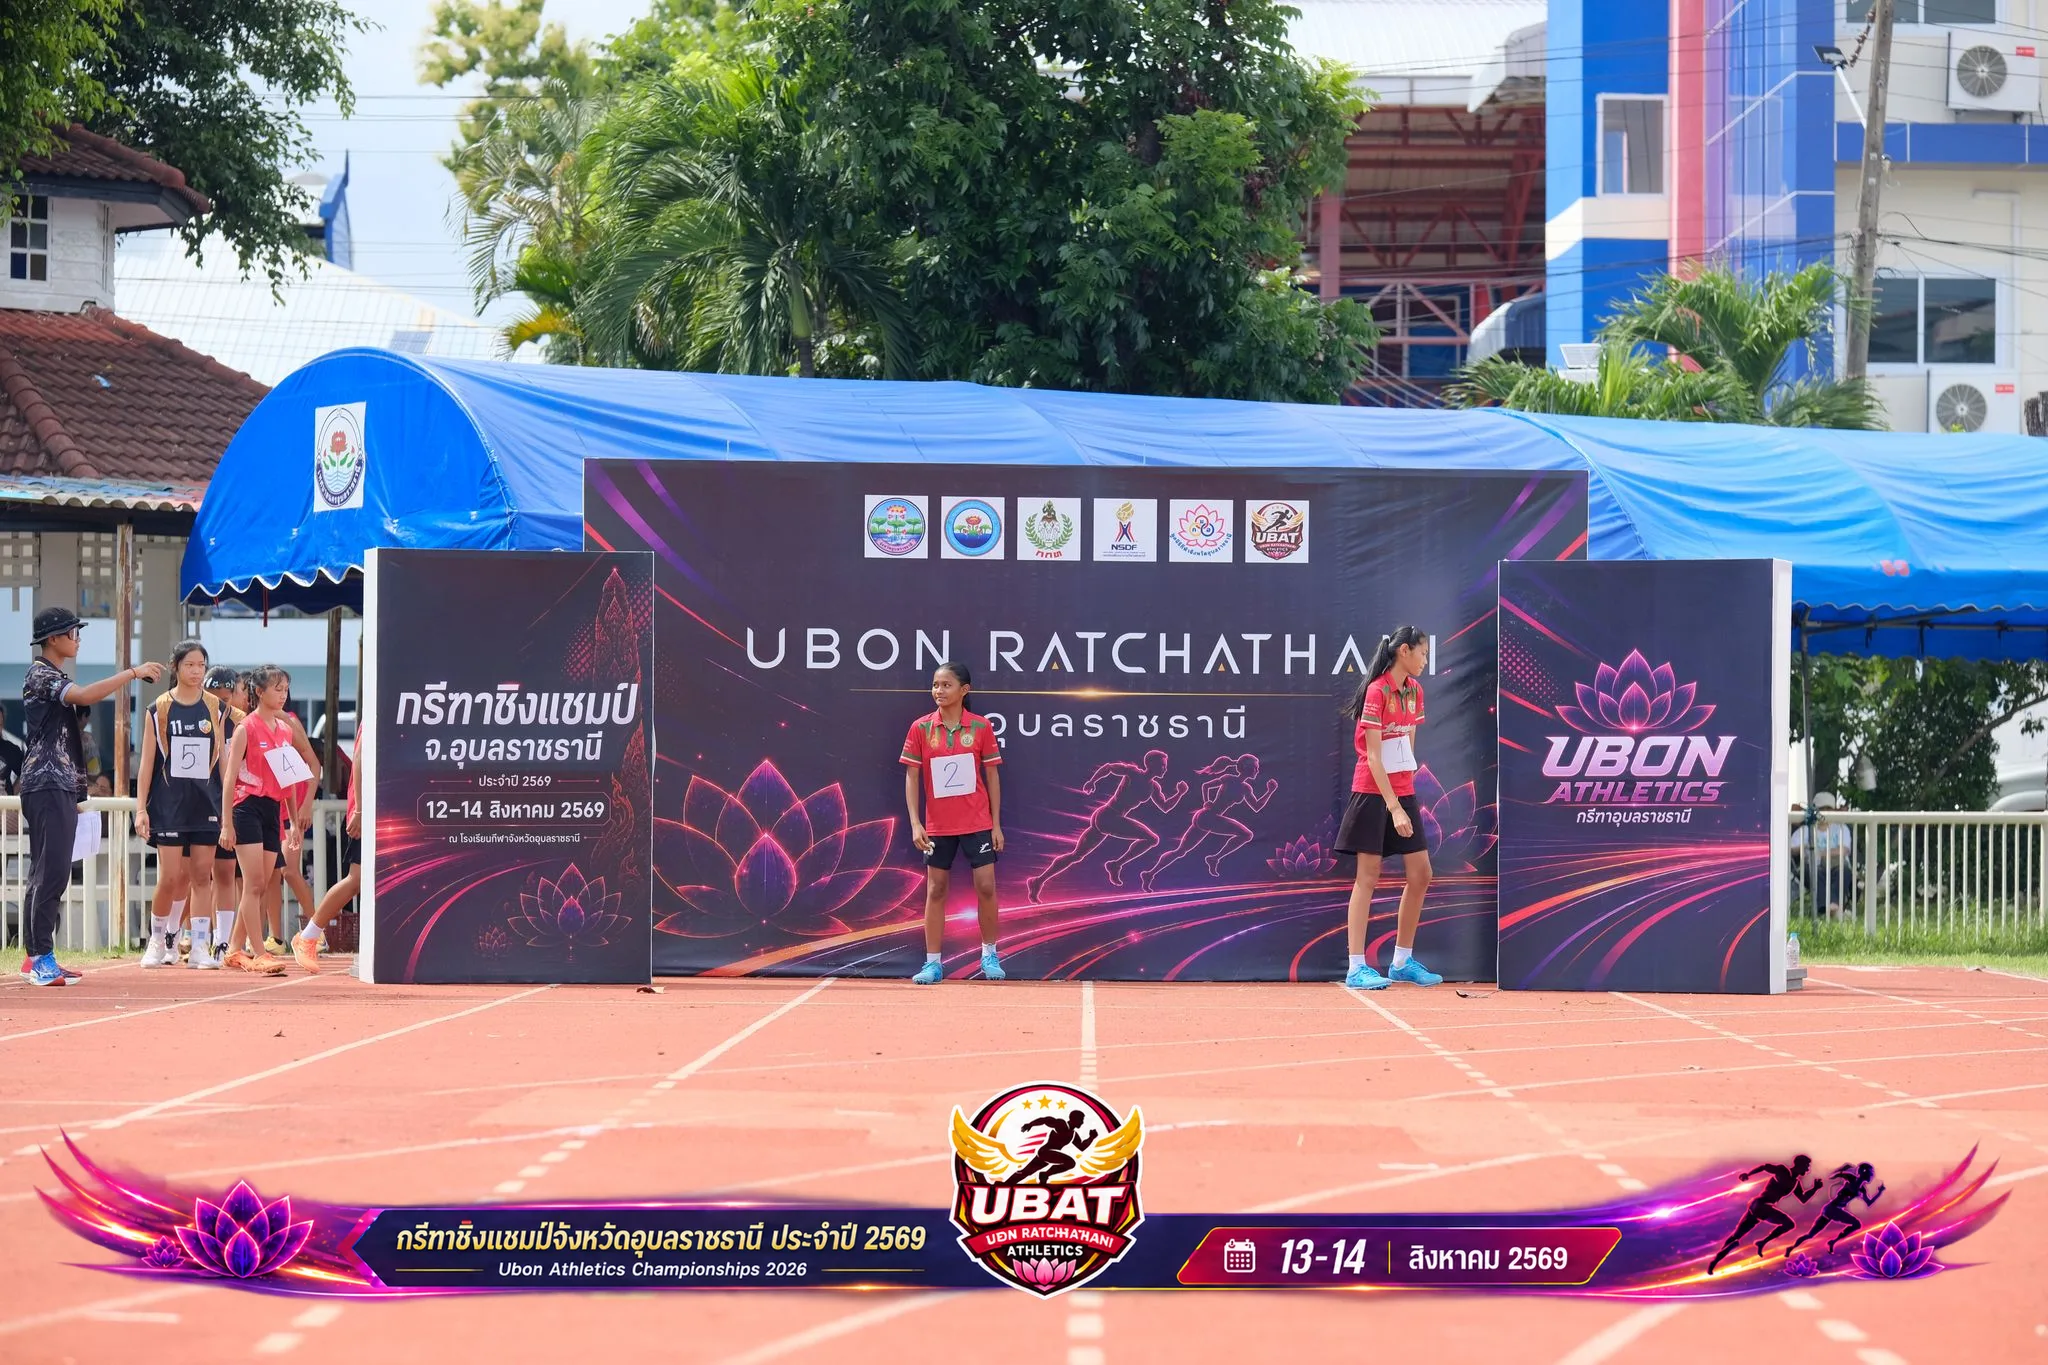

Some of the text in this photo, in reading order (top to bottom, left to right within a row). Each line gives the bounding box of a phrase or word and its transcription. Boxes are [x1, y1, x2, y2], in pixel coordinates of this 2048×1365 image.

[1256, 532, 1299, 543] UBAT
[1036, 550, 1062, 559] กกท
[746, 627, 1436, 676] UBON RATCHATHAI
[396, 681, 639, 725] กรีฑาชิงแชมป์
[170, 719, 183, 735] 11
[181, 744, 201, 770] 5
[425, 731, 603, 770] จ.อุบลราชธานี
[1396, 739, 1410, 764] 1
[1542, 736, 1738, 777] UBON
[282, 753, 297, 777] 4
[943, 761, 965, 788] 2
[478, 773, 552, 788] ประจำปี 2569
[1545, 781, 1729, 804] ATHLETICS
[490, 800, 554, 819] สิงหาคม
[561, 801, 605, 818] 2569
[1576, 808, 1692, 827] กรีฑาอุบลราชธานี
[449, 832, 580, 846] ณ โรงเรียนกีฬาจังหวัดอุบลราชธานี
